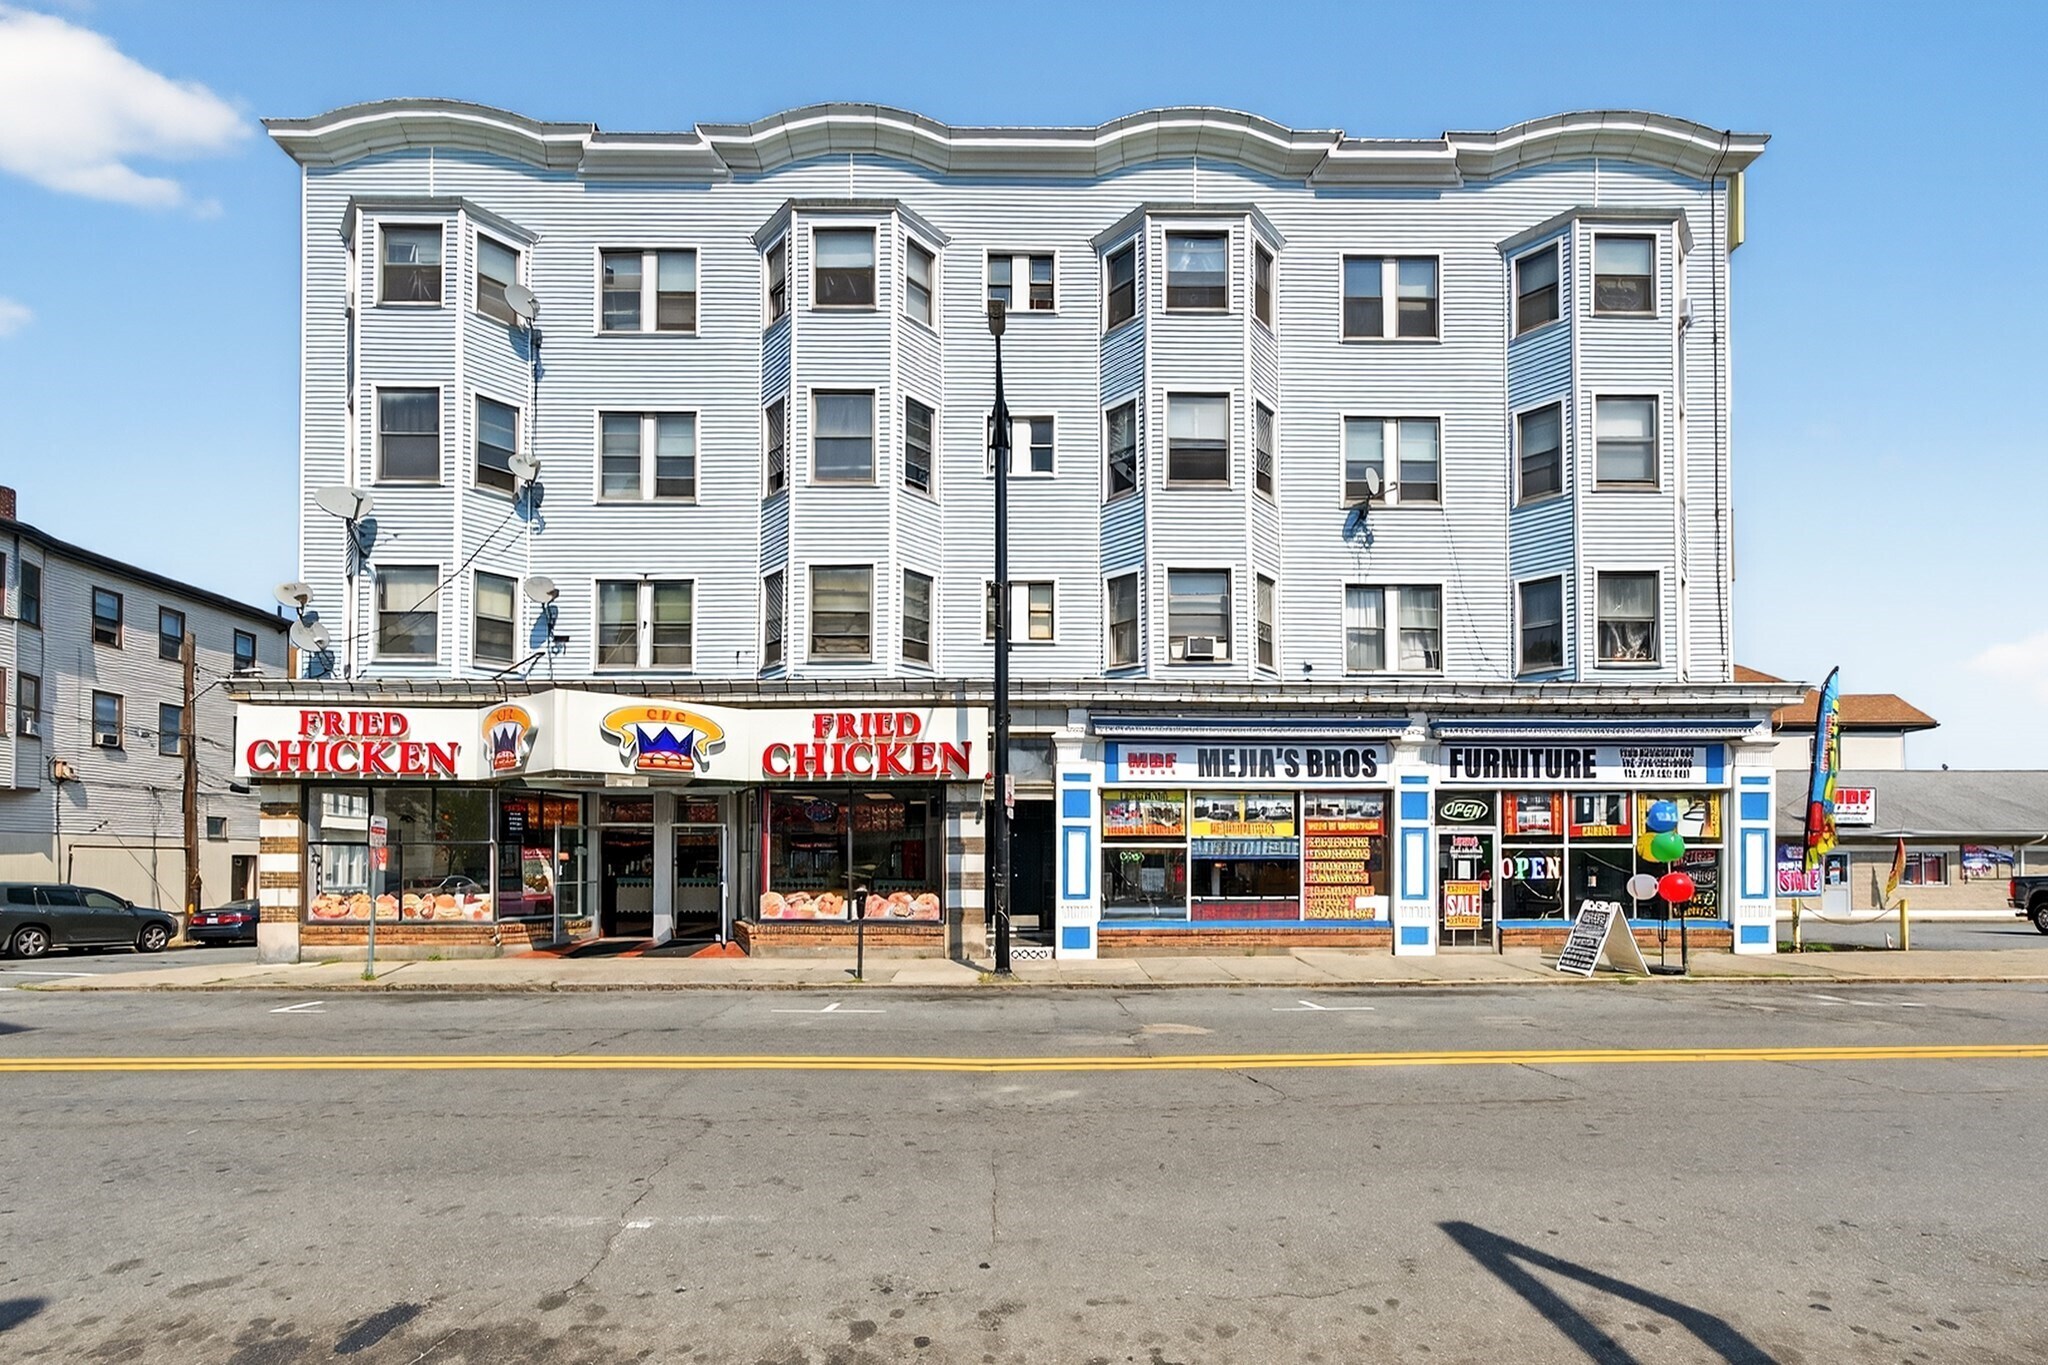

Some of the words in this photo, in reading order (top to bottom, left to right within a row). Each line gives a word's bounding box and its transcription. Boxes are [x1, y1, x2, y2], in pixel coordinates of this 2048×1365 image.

[298, 710, 408, 737] FRIED
[814, 712, 921, 738] FRIED
[247, 739, 459, 774] CHICKEN
[762, 741, 972, 776] CHICKEN
[1197, 748, 1299, 778] MEJIA'S
[1307, 749, 1377, 778] BROS
[1450, 748, 1597, 778] FURNITURE
[1443, 802, 1483, 819] OPEN
[1501, 856, 1561, 879] OPEN
[1447, 895, 1481, 916] SALE
